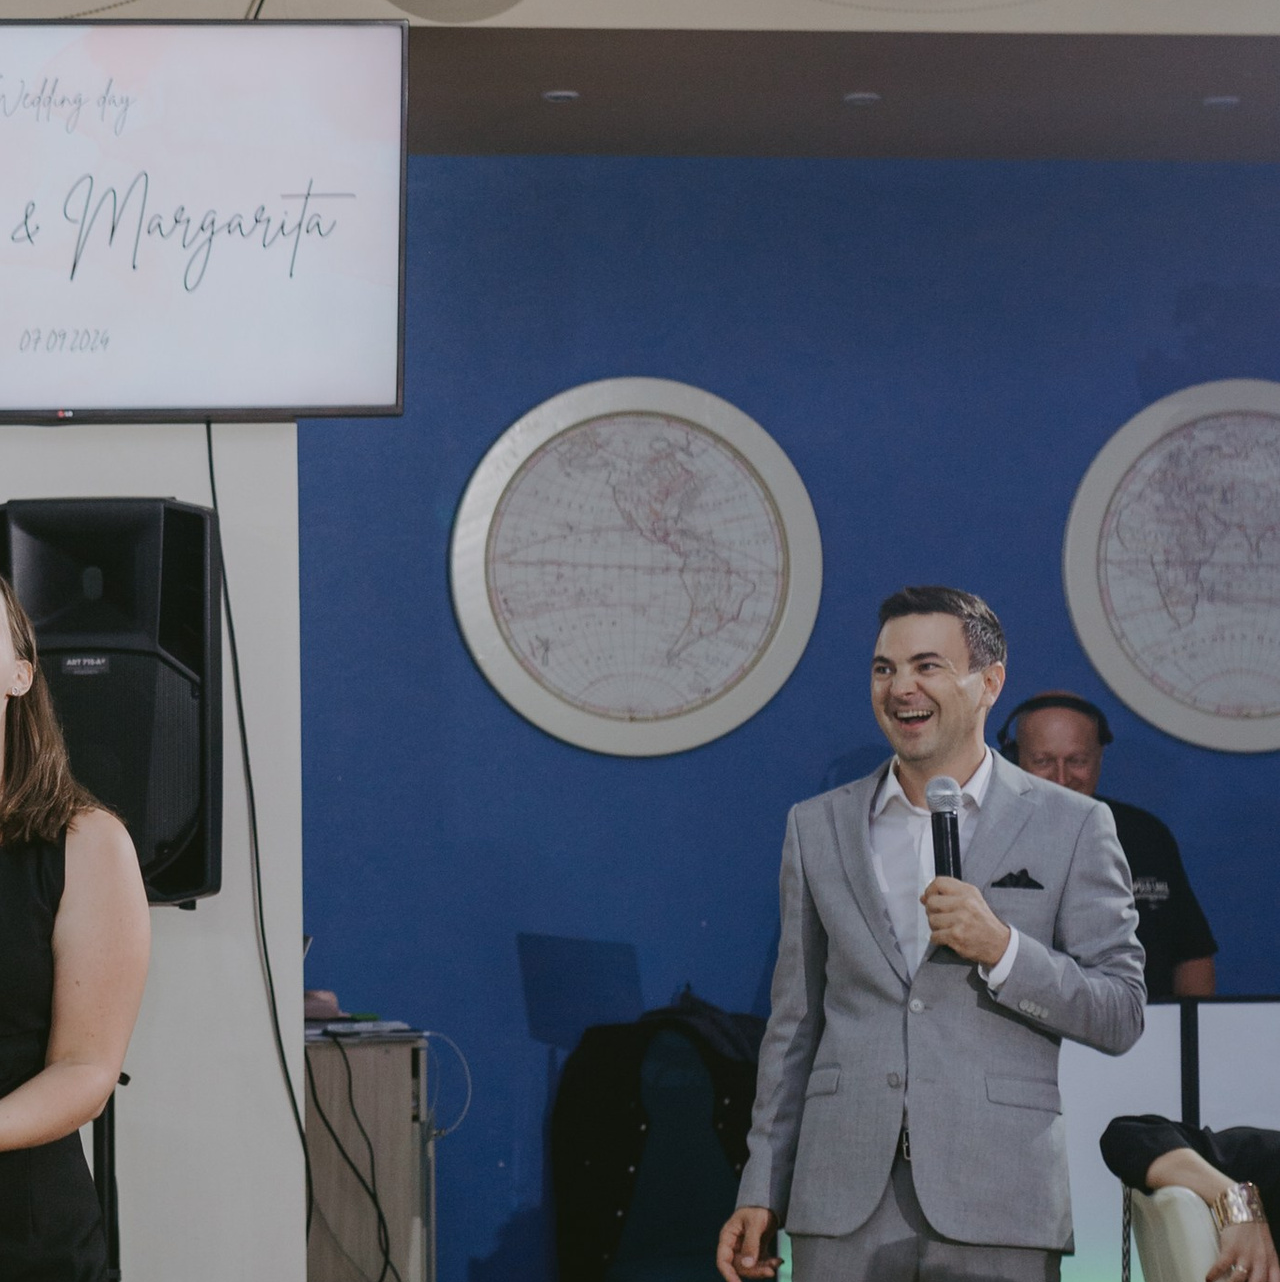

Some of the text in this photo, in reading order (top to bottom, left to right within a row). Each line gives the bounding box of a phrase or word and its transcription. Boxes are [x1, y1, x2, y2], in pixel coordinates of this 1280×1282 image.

[97, 77, 135, 136] day
[11, 202, 39, 244] &
[63, 171, 356, 292] Margarita
